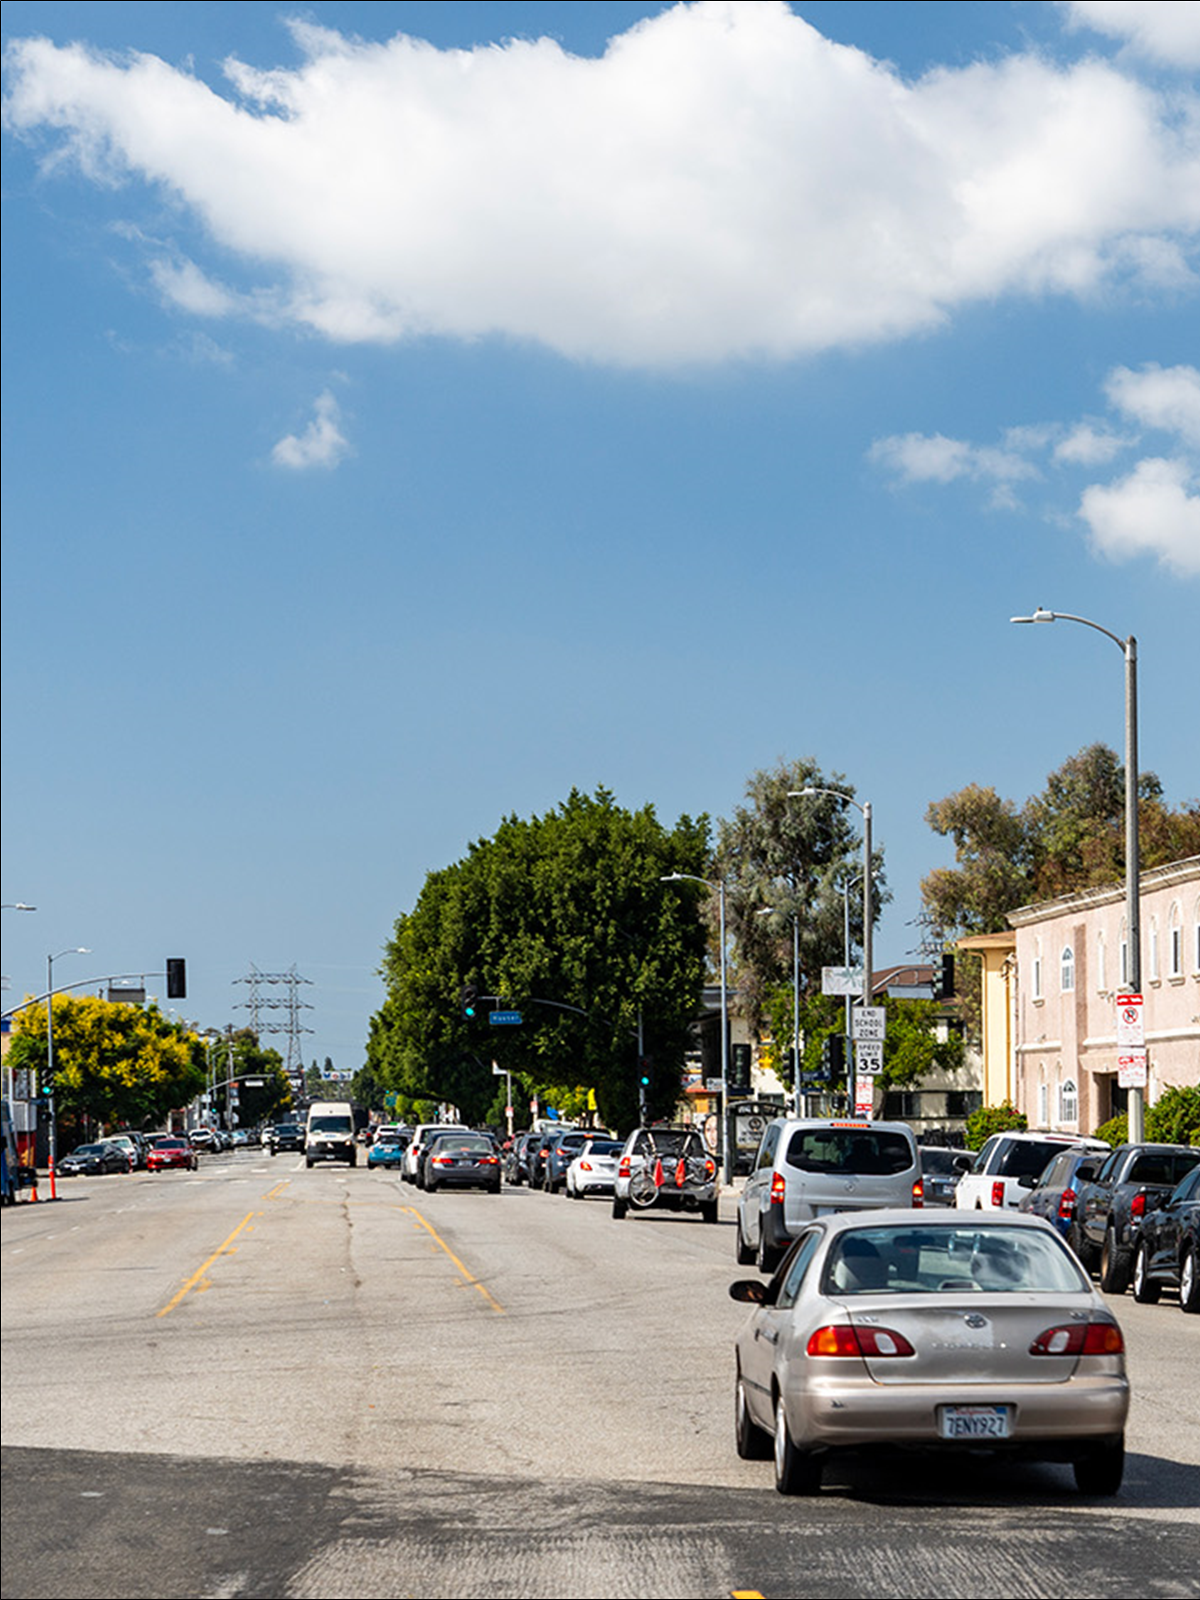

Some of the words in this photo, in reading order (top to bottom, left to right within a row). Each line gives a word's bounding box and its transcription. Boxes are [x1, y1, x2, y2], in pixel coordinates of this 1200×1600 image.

[861, 1010, 876, 1018] END
[855, 1019, 882, 1027] SCHOOL
[859, 1029, 878, 1037] ZONE
[859, 1058, 880, 1071] 35
[946, 1416, 1005, 1435] 7ENY927
